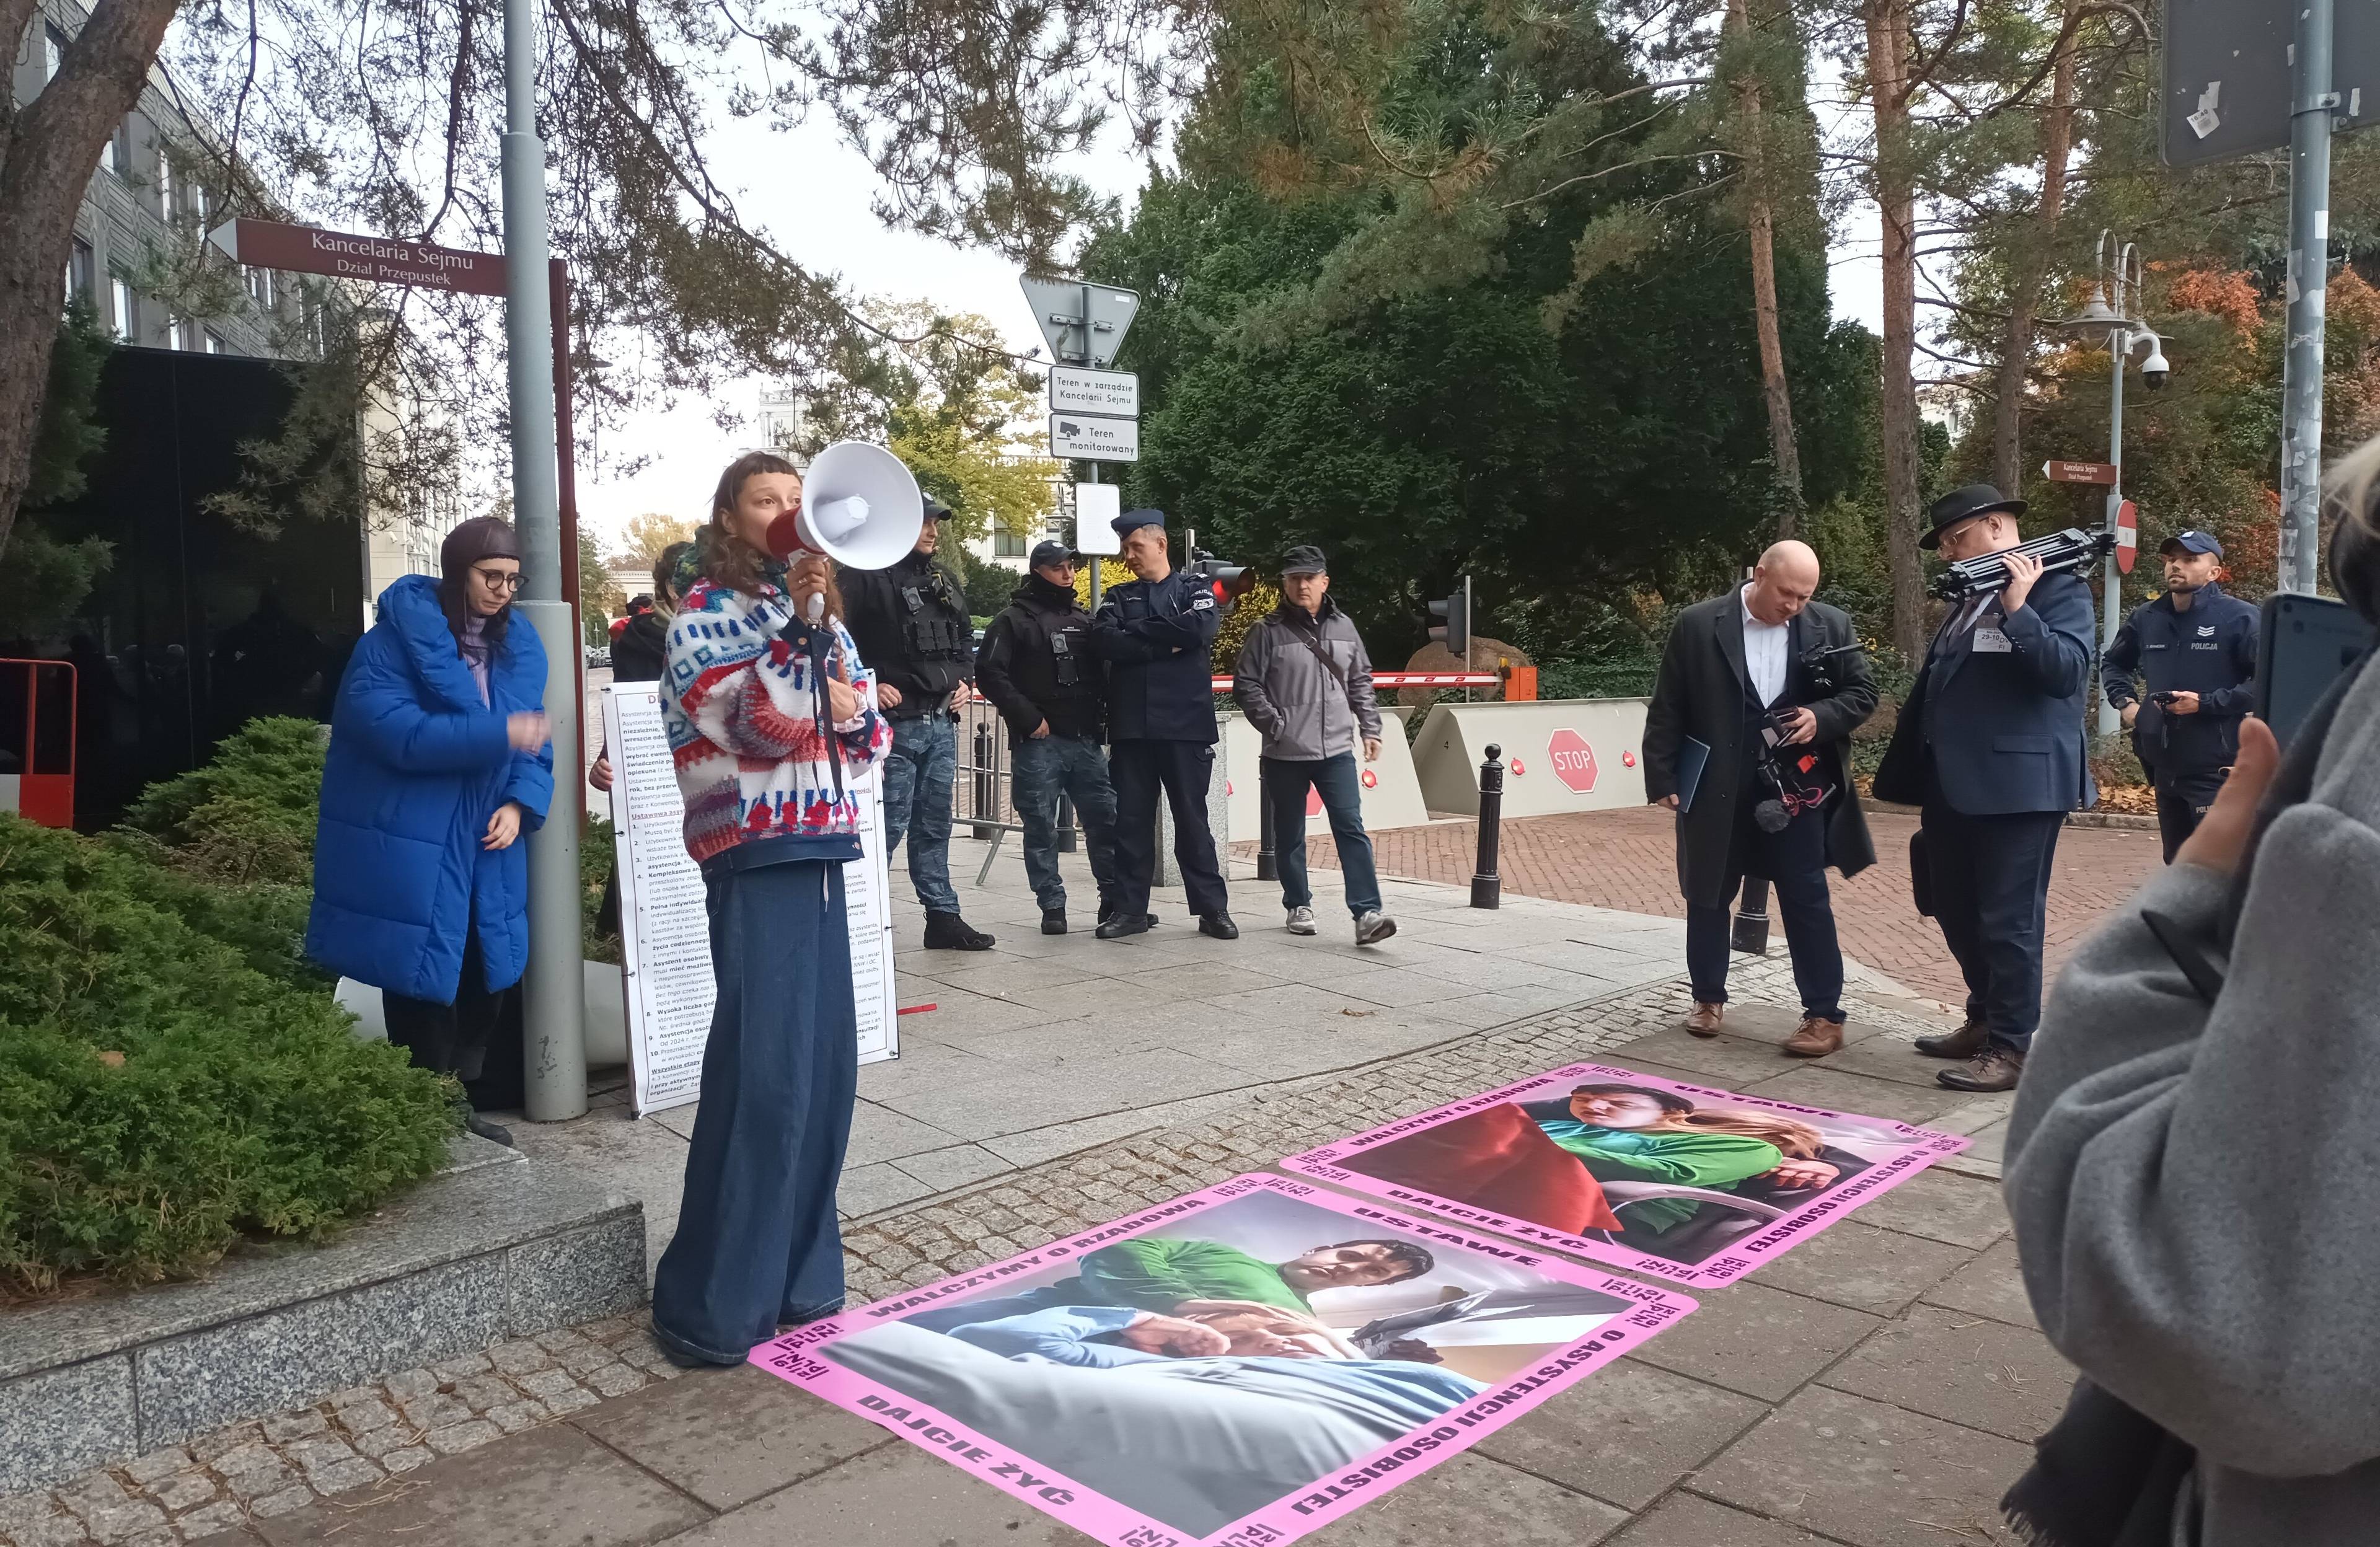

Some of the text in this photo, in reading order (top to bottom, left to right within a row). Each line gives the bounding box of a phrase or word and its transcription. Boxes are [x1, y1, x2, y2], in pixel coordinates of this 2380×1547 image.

[312, 232, 474, 271] Kancelaria Sejmu
[337, 259, 451, 285] Dział Przepustek
[1057, 377, 1080, 387] Teren
[1095, 382, 1133, 393] zarządzie
[1060, 390, 1131, 405] Kancelarii Sejmu
[1070, 442, 1135, 456] monitorowany
[1089, 428, 1114, 438] Teren
[1443, 741, 1449, 750] 4
[1554, 750, 1590, 770] STOP
[1349, 1110, 1455, 1146] WALCZYMY
[1830, 1155, 1918, 1202] ASYSTENCJI
[1386, 1189, 1589, 1250] DAJCIE ŻYĆ
[1745, 1201, 1838, 1253] OSOBISTEJ
[866, 1256, 1042, 1318] WALCZYMY
[1047, 1247, 1072, 1258] O
[1291, 1330, 1626, 1515] O ASYSTENCJI OSOBISTEJ
[857, 1395, 1075, 1505] DAJCIE ŻYĆ
